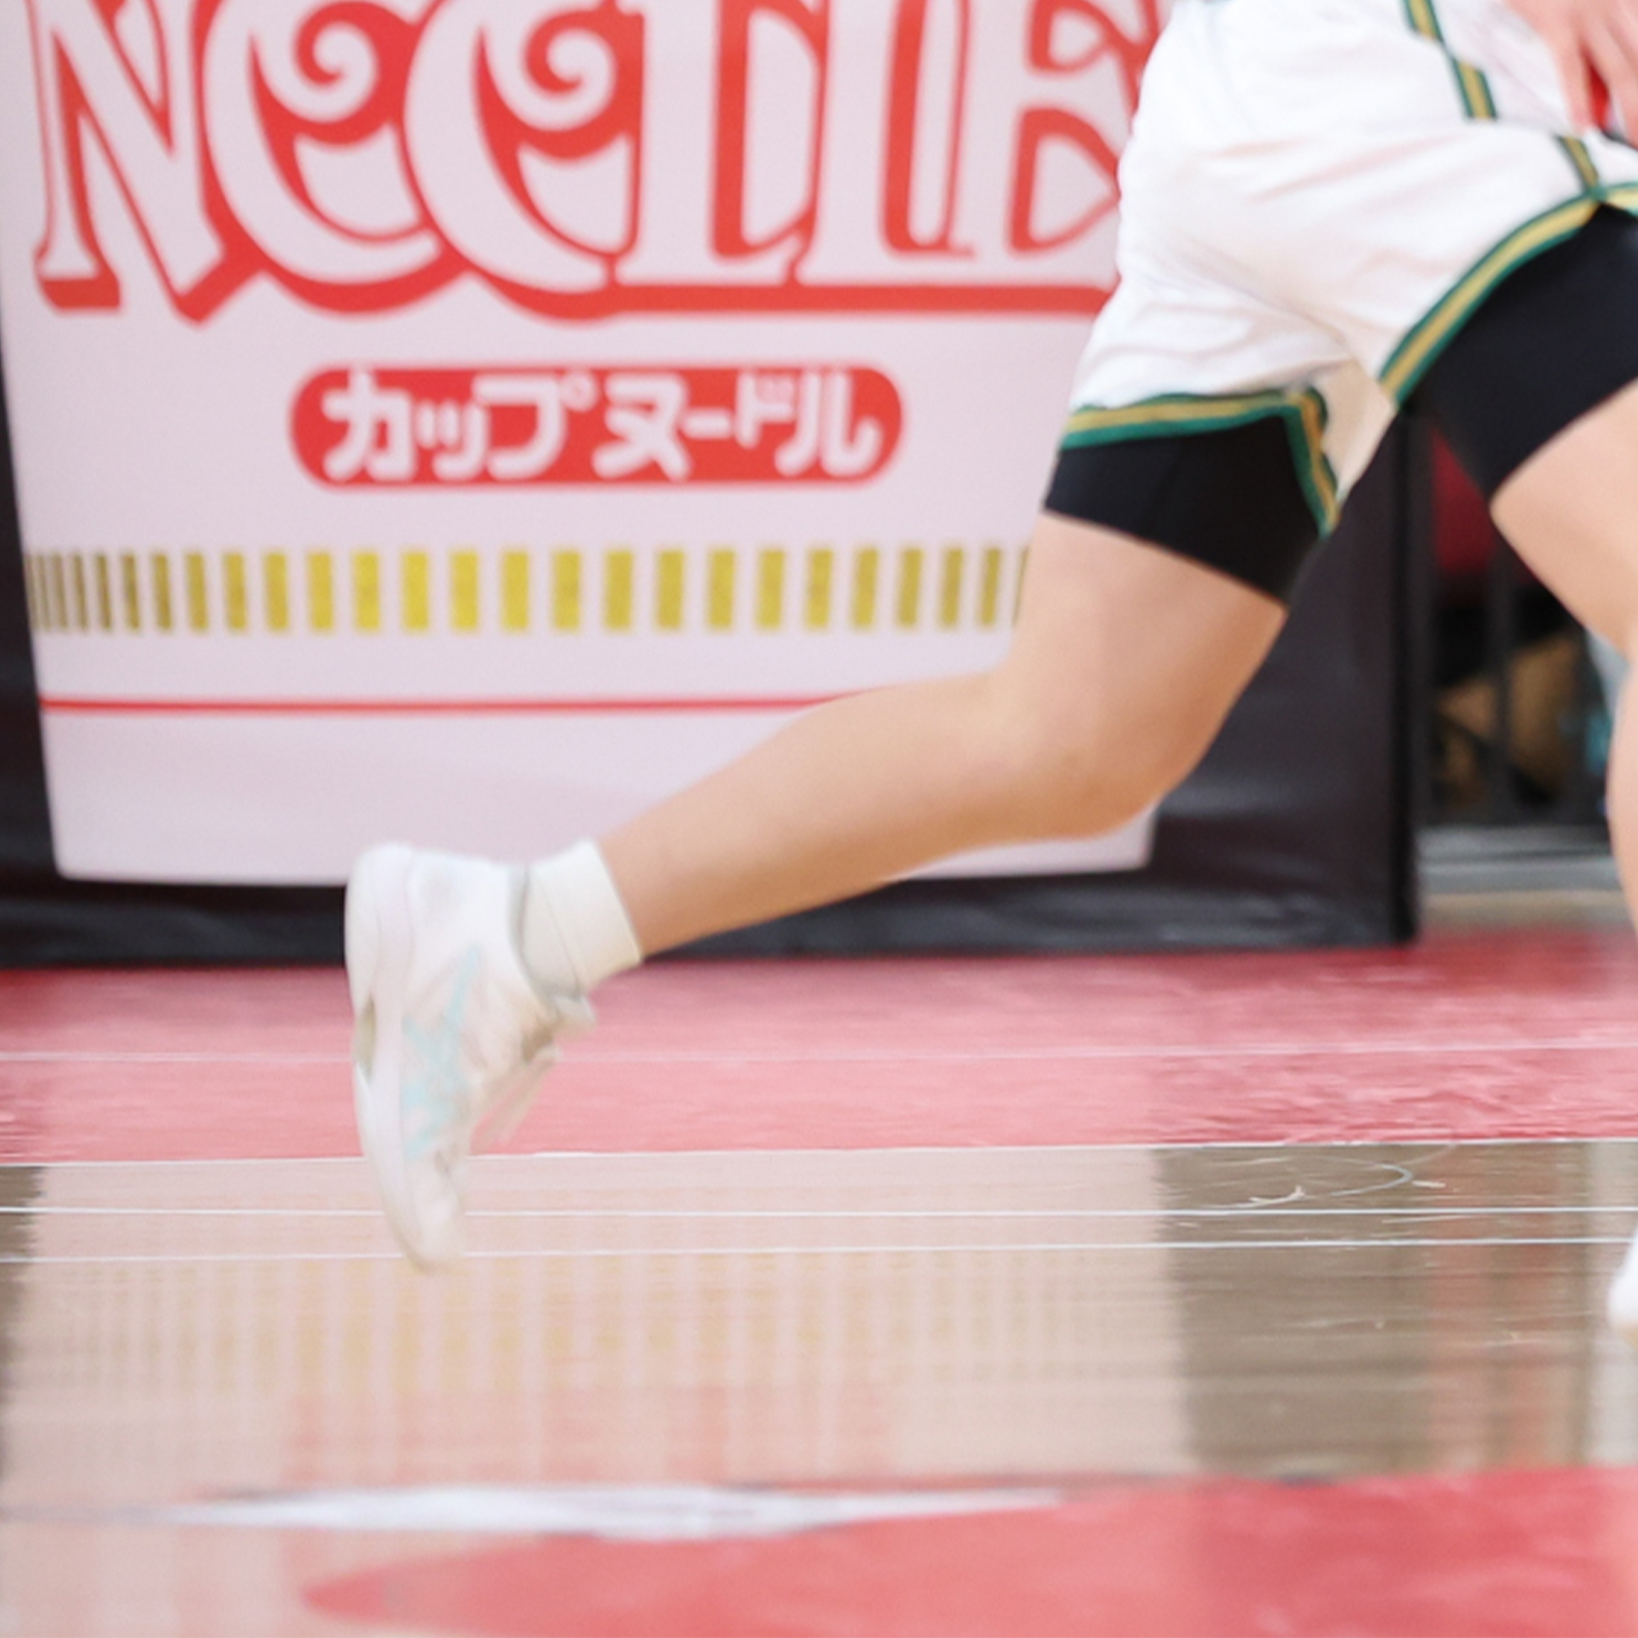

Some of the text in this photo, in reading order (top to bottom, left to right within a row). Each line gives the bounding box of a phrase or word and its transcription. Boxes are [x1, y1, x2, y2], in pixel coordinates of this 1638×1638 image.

[322, 368, 882, 481] カップヌードル
